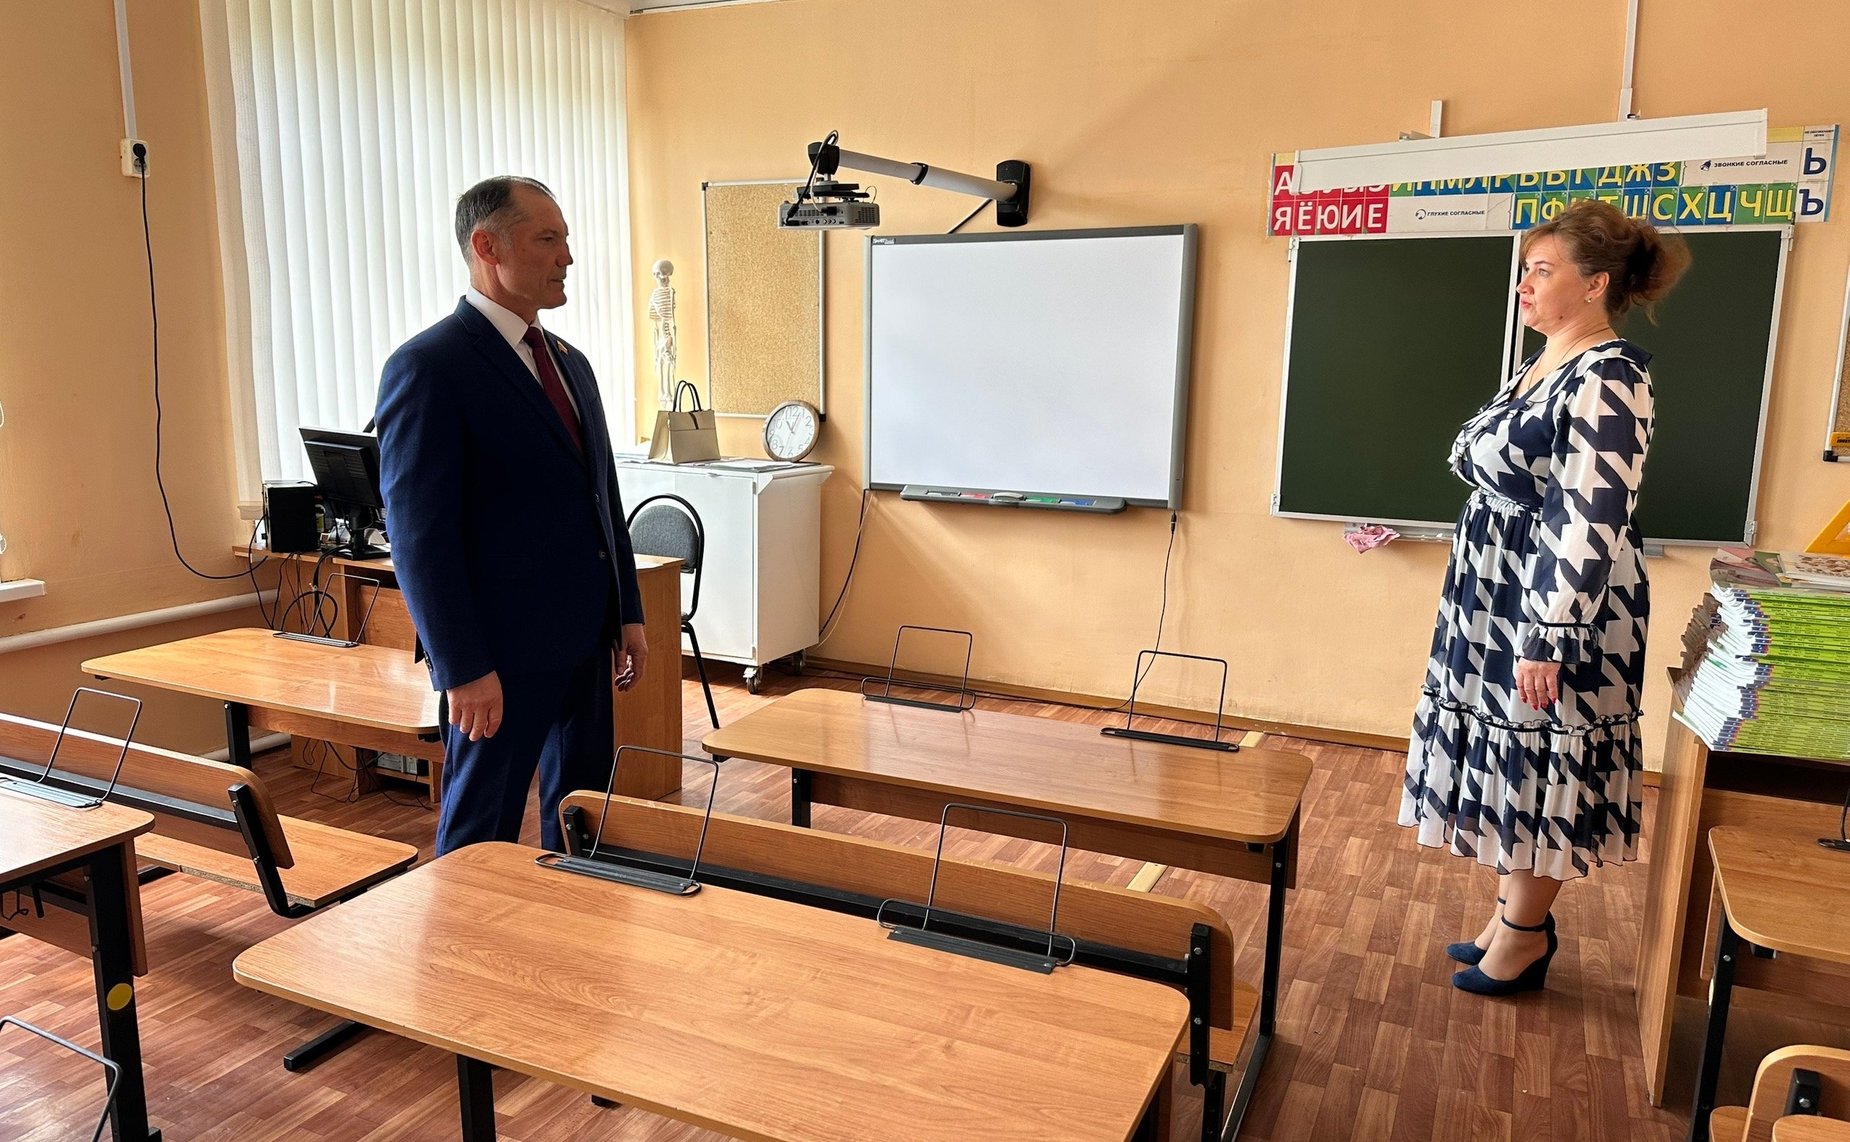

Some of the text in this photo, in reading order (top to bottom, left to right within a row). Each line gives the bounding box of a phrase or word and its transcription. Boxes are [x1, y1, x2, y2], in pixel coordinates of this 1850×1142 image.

[1746, 159, 1789, 167] СОГЛАСНЫЕ
[1803, 147, 1827, 175] Ь
[1798, 188, 1824, 216] Ъ
